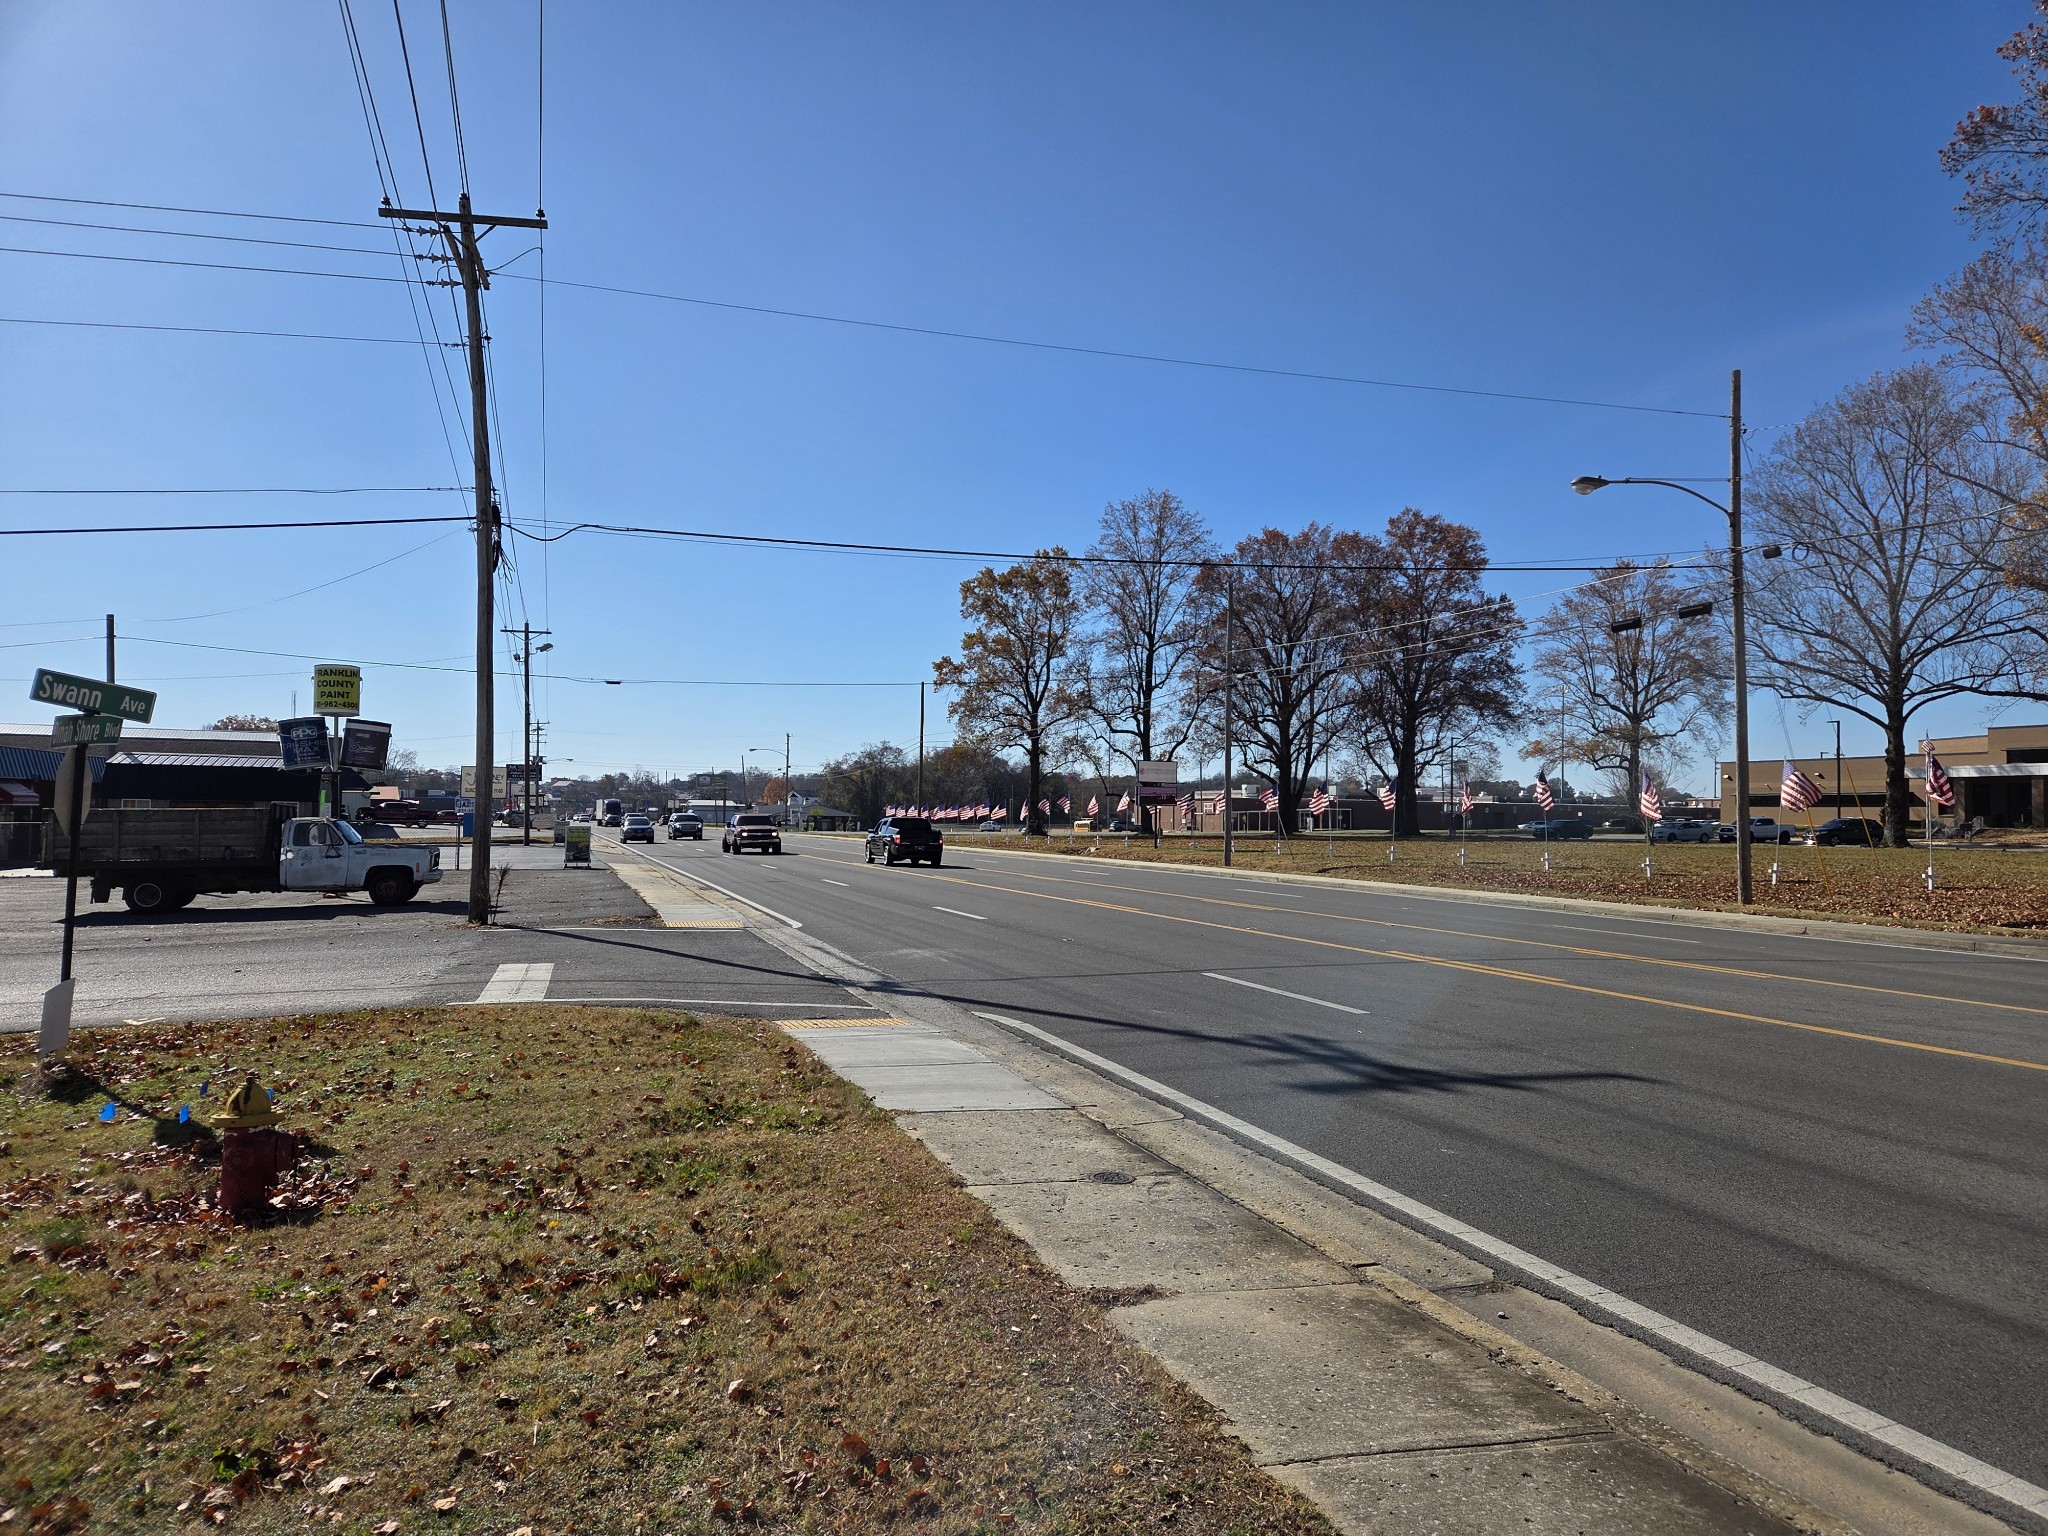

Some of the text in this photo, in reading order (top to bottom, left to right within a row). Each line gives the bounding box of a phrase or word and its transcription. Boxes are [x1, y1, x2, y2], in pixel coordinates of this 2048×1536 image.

[315, 669, 358, 678] FRANKLIN
[316, 680, 355, 688] COUNTY
[39, 675, 146, 714] Swann Ave
[320, 691, 351, 699] PAINT
[52, 719, 121, 745] Dinah Shore Blvd
[292, 728, 316, 738] PPG
[293, 745, 320, 754] MAX
